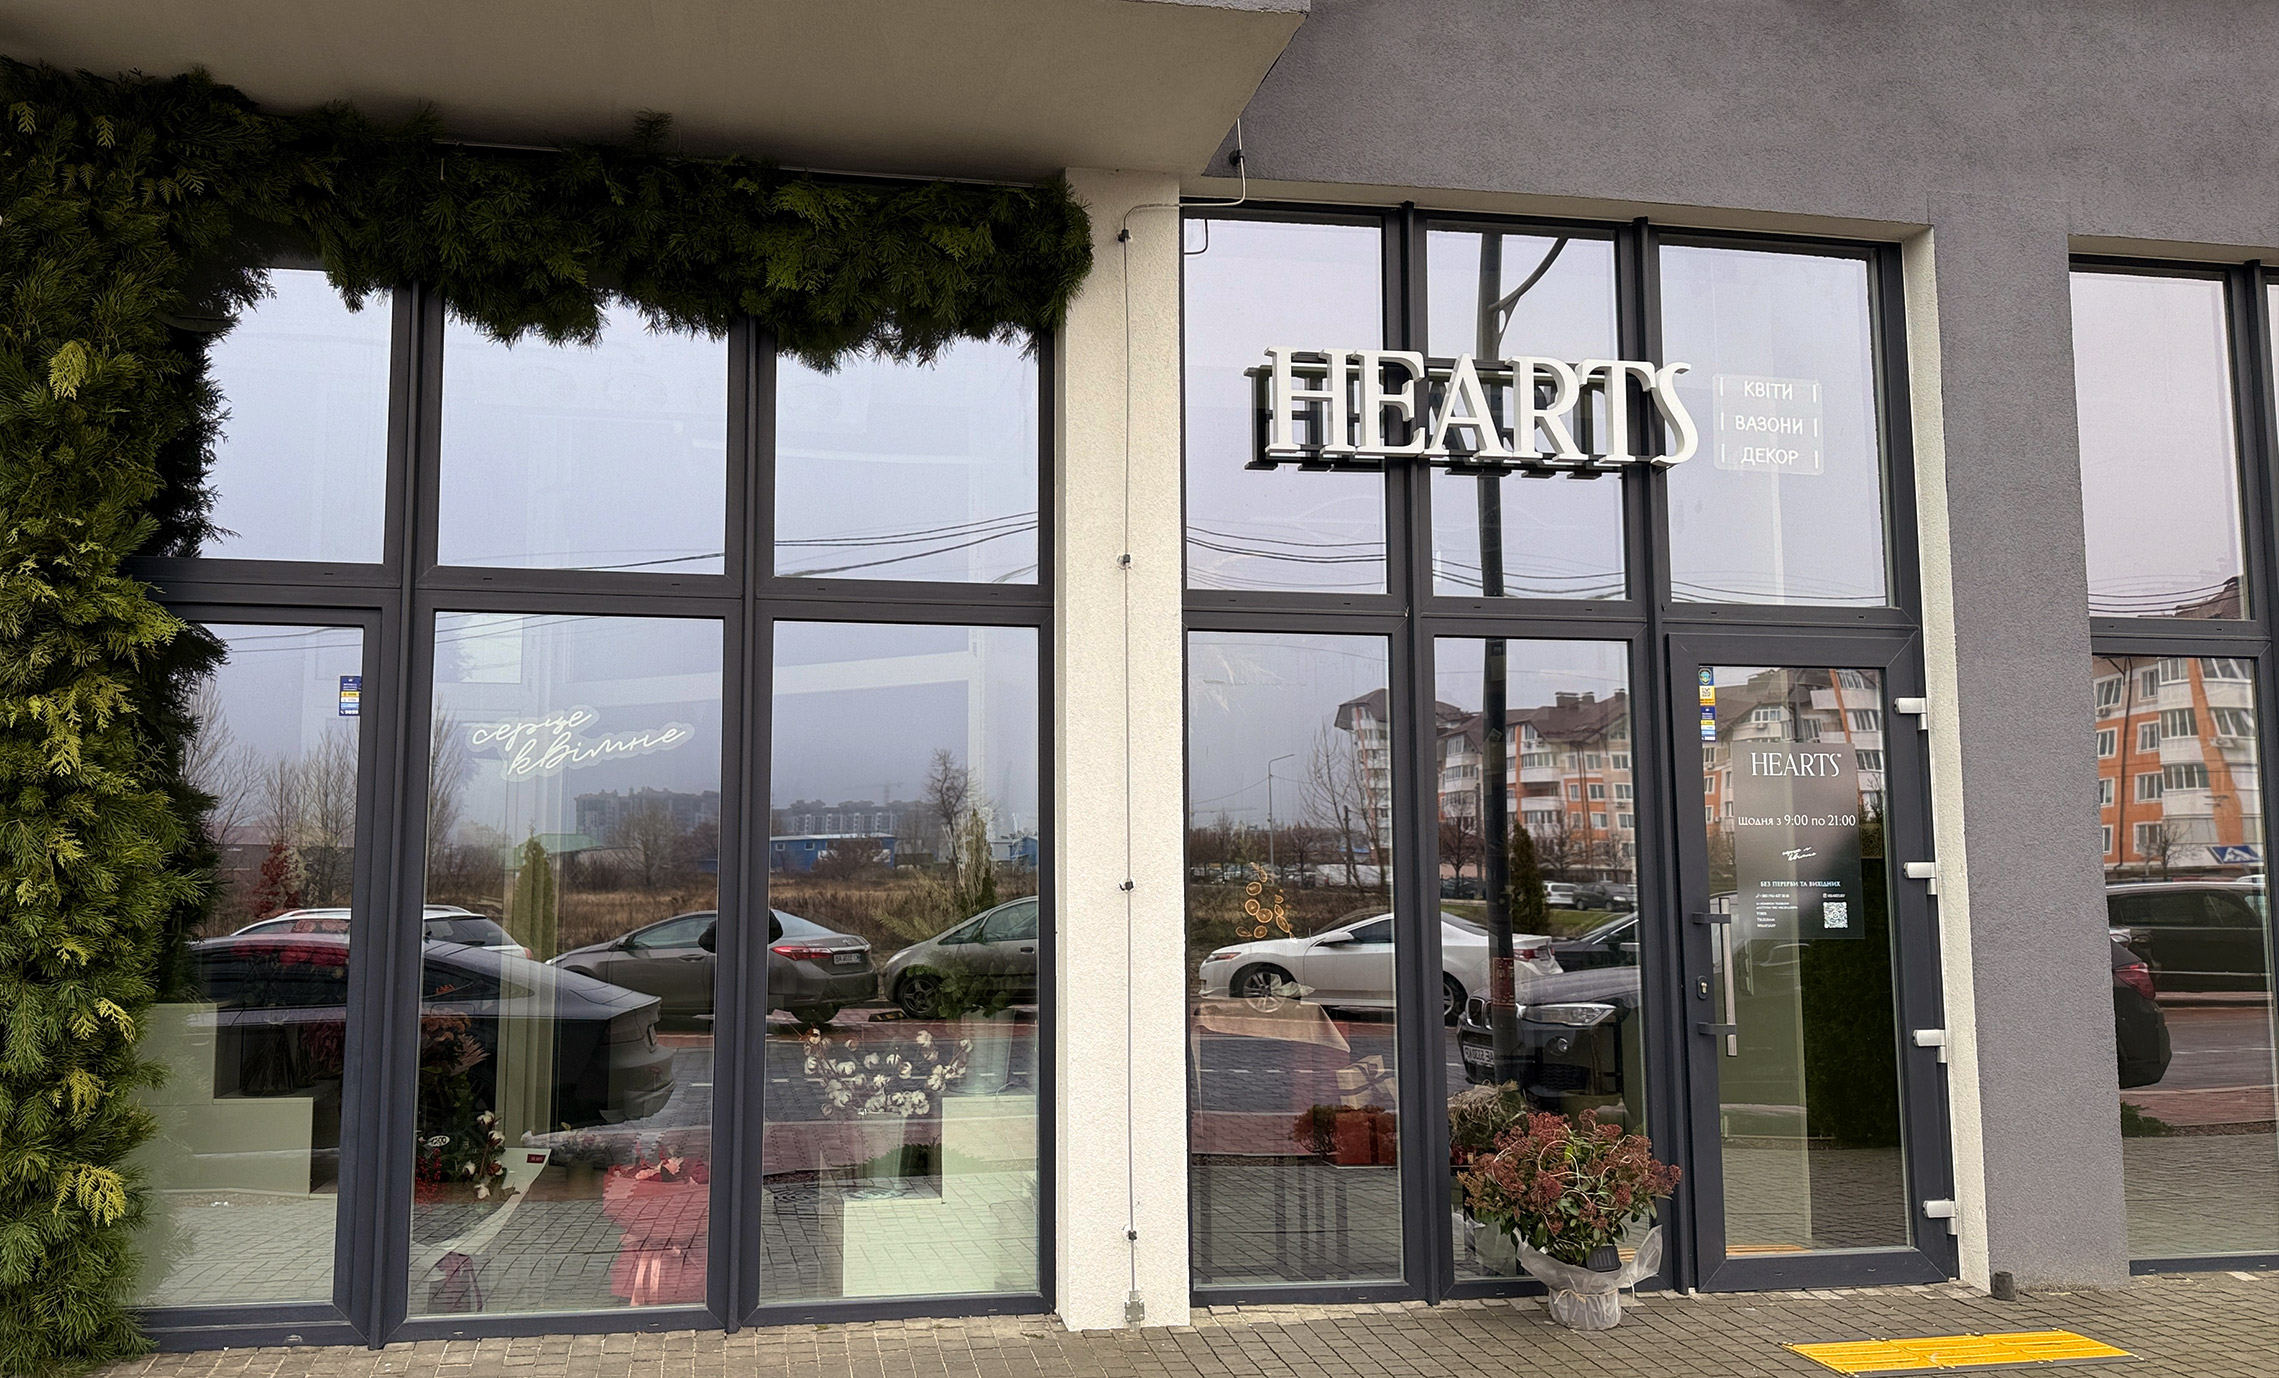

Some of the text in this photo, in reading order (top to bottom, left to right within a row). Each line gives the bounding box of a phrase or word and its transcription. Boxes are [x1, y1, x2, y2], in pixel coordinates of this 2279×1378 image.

[1744, 380, 1793, 400] КВІТИ
[1264, 346, 1699, 466] HEARTS
[1735, 415, 1803, 435] ВАЗОНИ
[1740, 447, 1799, 466] ДЕКОР
[472, 710, 592, 752] серце
[507, 726, 685, 775] квітне
[1750, 752, 1841, 777] HEARTS
[1783, 814, 1809, 826] 9:00
[1811, 817, 1826, 826] по
[1827, 814, 1856, 827] 21:00
